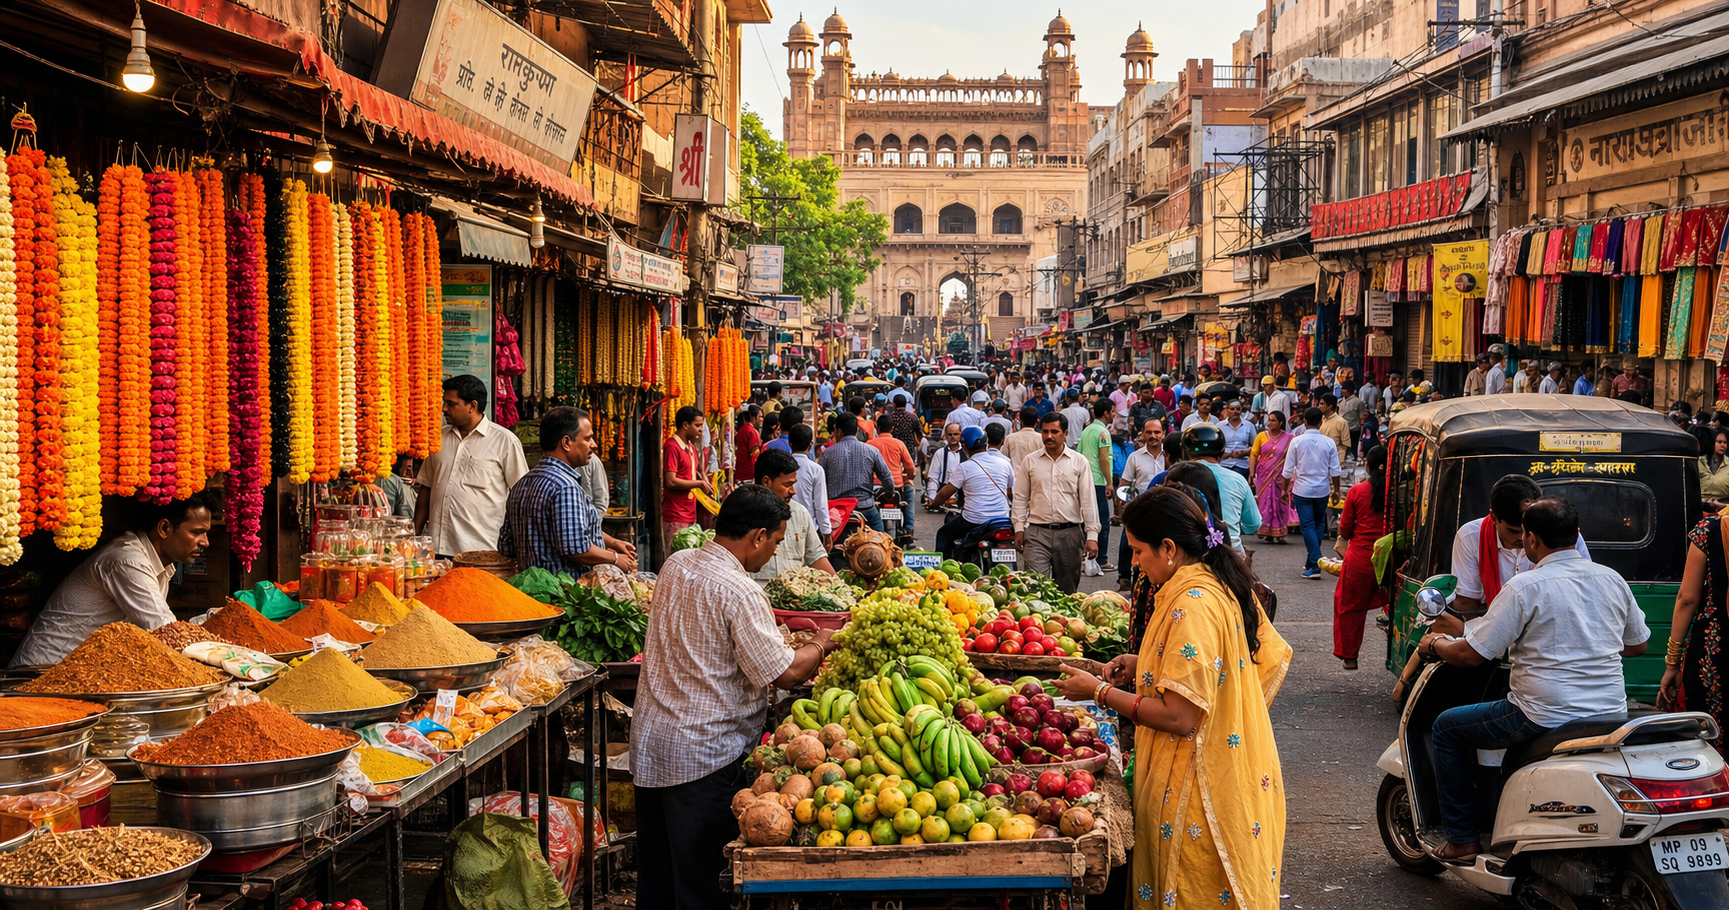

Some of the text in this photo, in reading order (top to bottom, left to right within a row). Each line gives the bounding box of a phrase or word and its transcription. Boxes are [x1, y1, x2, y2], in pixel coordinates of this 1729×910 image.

[679, 131, 704, 188] श्री
[1661, 838, 1707, 854] MP 09
[1661, 853, 1722, 871] SQ 9899
